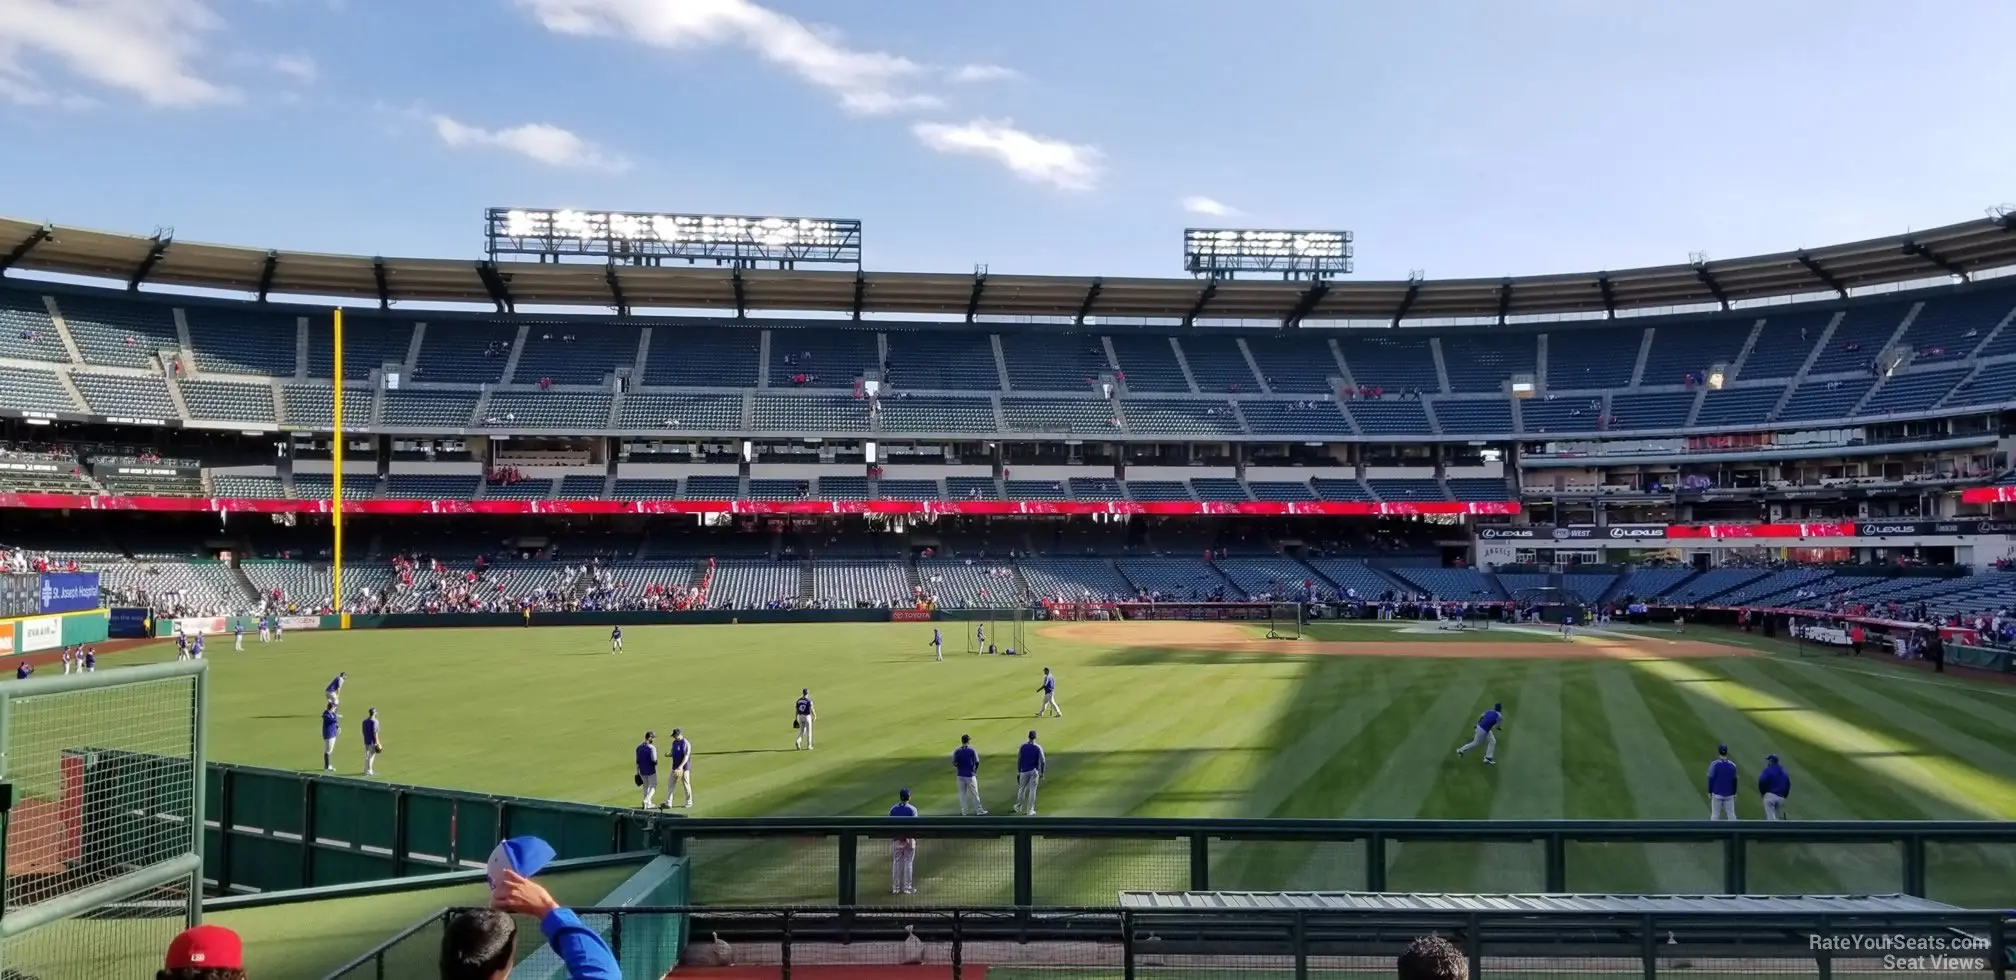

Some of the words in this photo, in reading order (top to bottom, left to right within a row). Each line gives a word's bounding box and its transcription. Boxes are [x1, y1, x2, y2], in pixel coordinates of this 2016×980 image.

[1496, 529, 1533, 537] LEXUS
[1876, 525, 1915, 533] LEXUS
[60, 586, 78, 600] Joseph
[79, 584, 99, 599] Hospital
